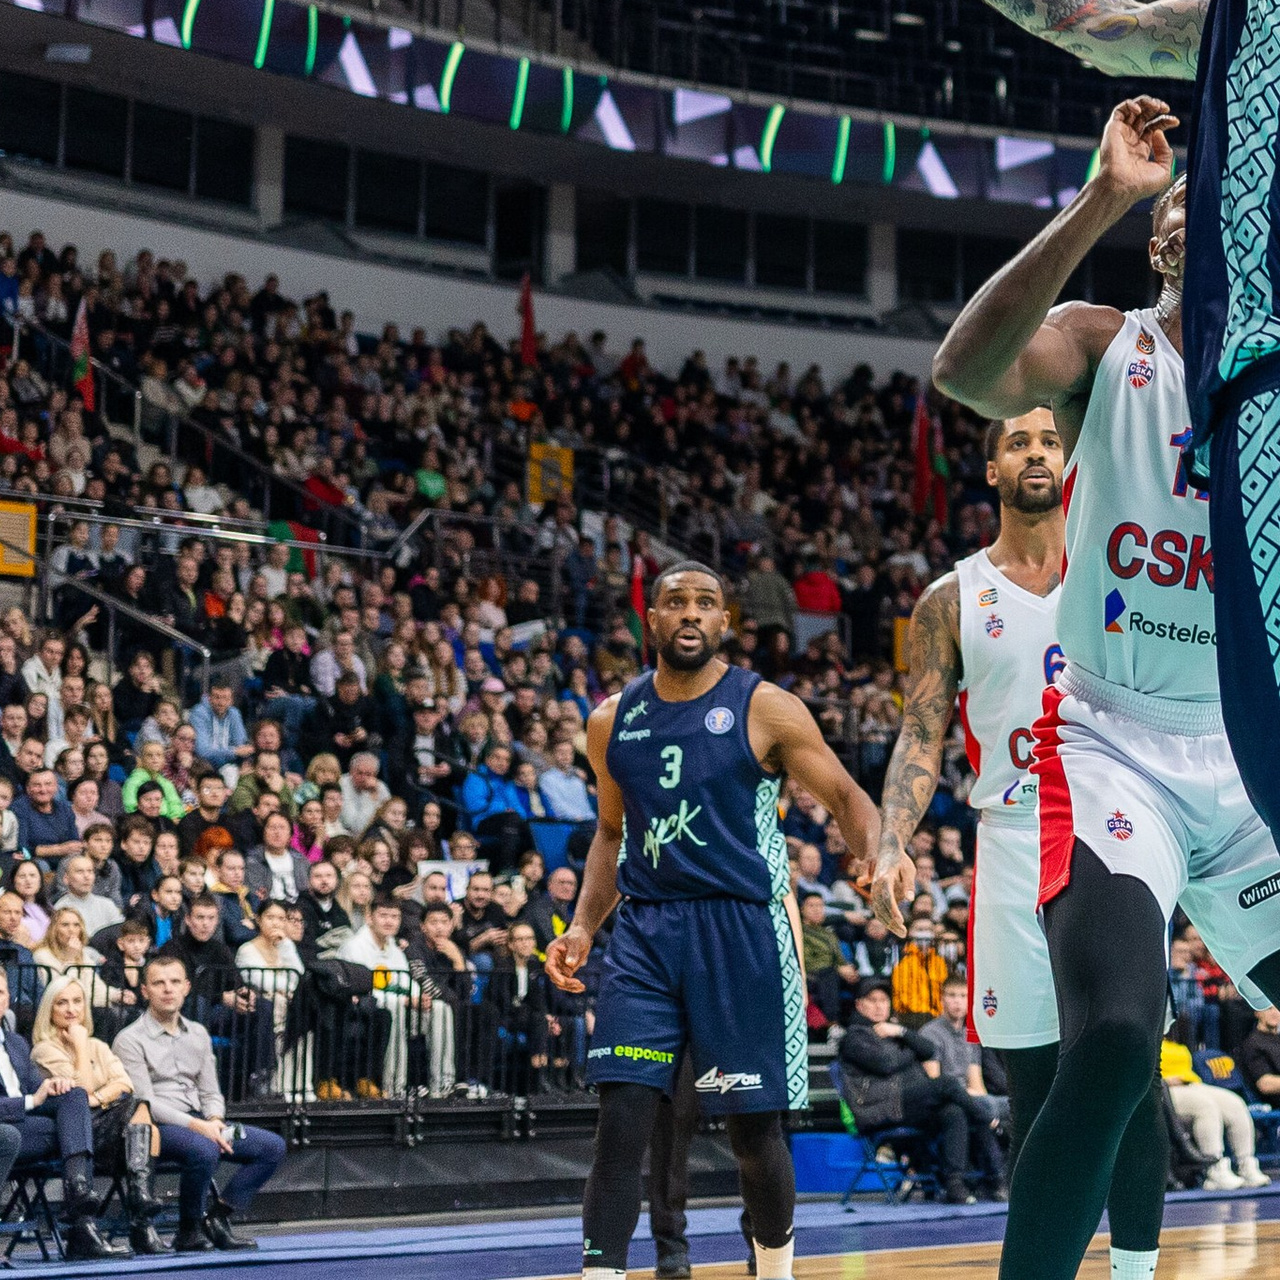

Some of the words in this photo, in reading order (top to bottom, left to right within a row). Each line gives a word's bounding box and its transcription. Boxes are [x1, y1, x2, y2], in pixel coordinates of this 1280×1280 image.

[1130, 364, 1152, 376] CSKA
[1170, 426, 1209, 501] 1
[659, 745, 683, 789] 3
[1022, 784, 1037, 795] R
[1108, 821, 1132, 831] CSKA
